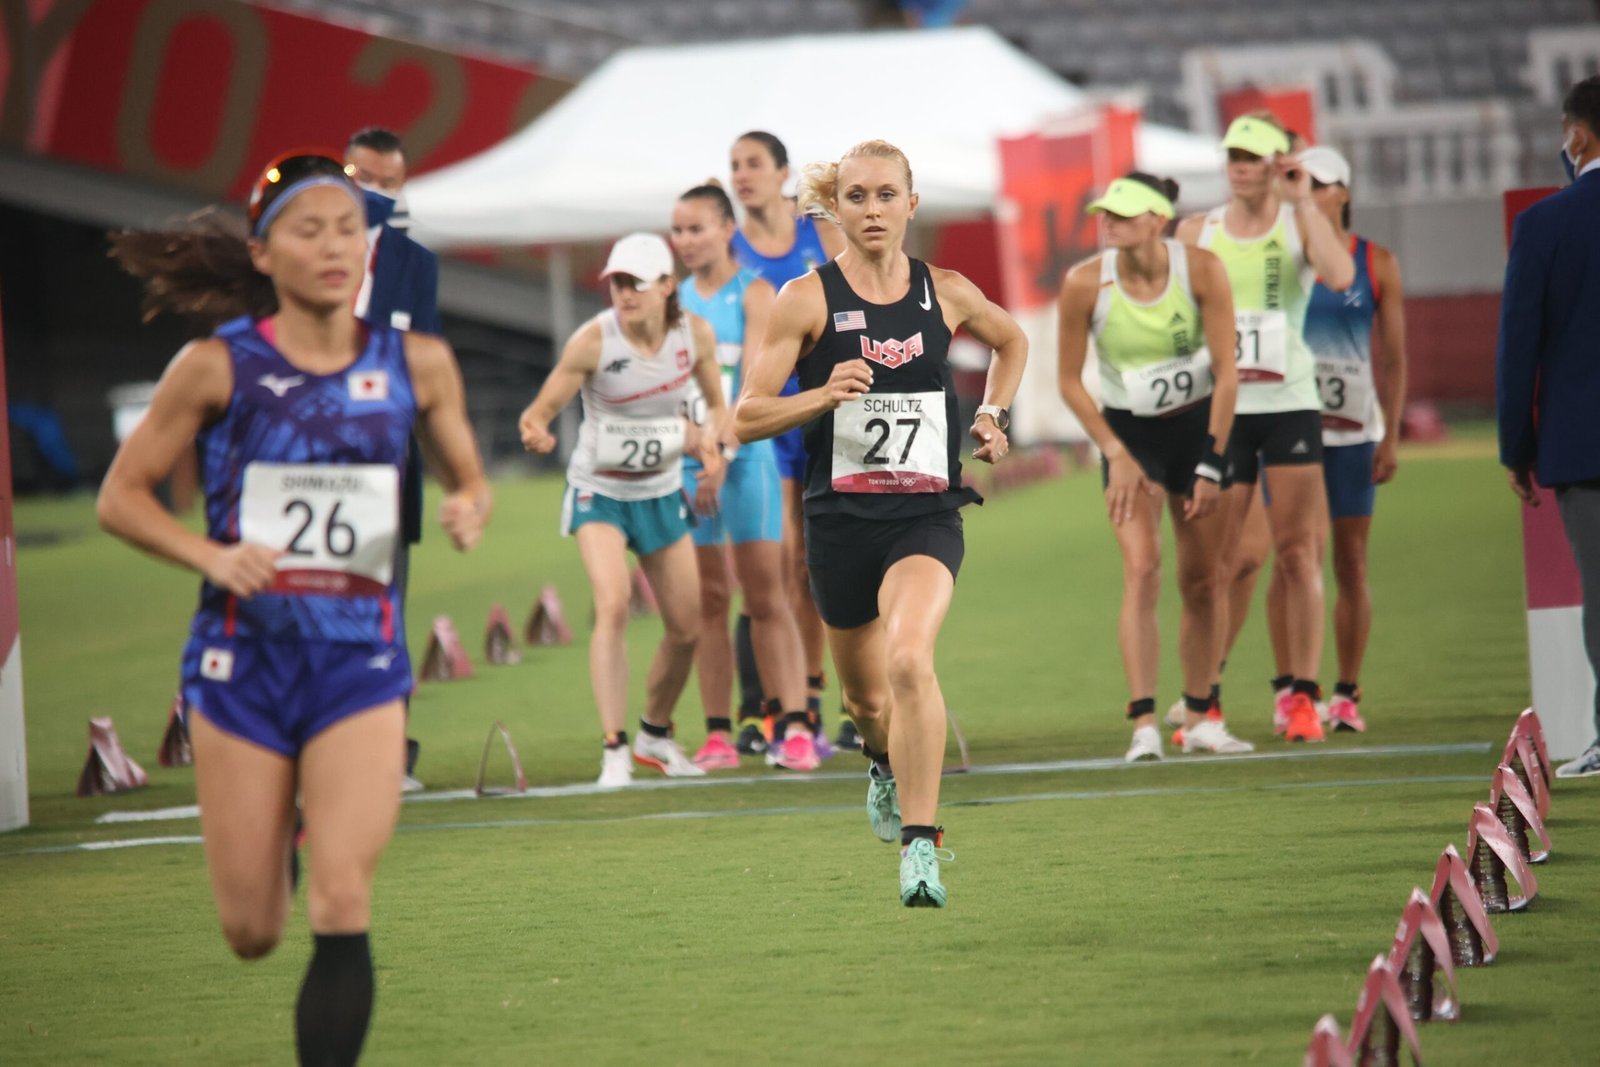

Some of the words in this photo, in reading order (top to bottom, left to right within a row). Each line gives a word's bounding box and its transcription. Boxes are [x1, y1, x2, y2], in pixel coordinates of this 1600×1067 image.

[860, 332, 924, 369] USA
[864, 398, 923, 414] SCHULTZ
[1151, 370, 1194, 409] 29
[1315, 376, 1346, 410] 3
[620, 439, 662, 469] 28
[863, 418, 921, 465] 27
[868, 478, 886, 486] TOKYO
[283, 499, 356, 557] 26
